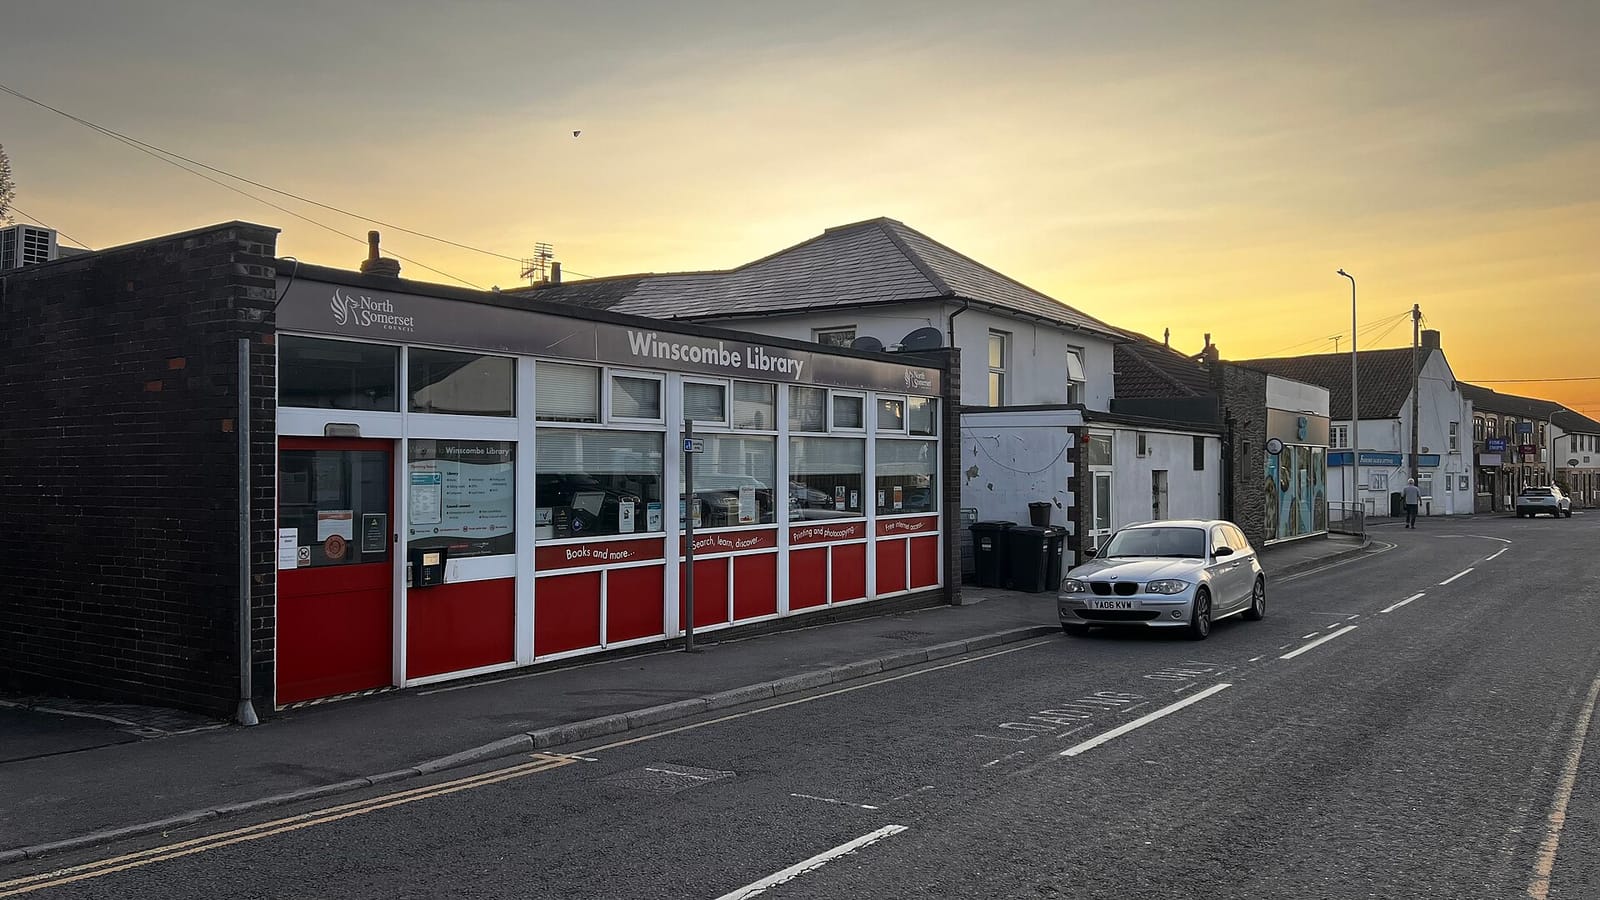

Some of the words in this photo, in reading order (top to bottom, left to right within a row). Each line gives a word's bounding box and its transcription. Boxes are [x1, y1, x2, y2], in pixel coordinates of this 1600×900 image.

[360, 295, 393, 313] North
[360, 310, 415, 327] Somerset
[383, 324, 415, 332] COUNCIL
[627, 330, 742, 367] Winscombe
[746, 346, 805, 381] Library
[445, 446, 485, 455] Winscombe
[486, 447, 510, 456] Library
[793, 527, 813, 542] Printing
[813, 526, 823, 536] and
[885, 522, 895, 532] Free
[692, 535, 716, 550] Search,
[717, 535, 734, 549] learn,
[566, 545, 591, 560] Books
[592, 547, 609, 560] and
[1094, 601, 1114, 609] YA06
